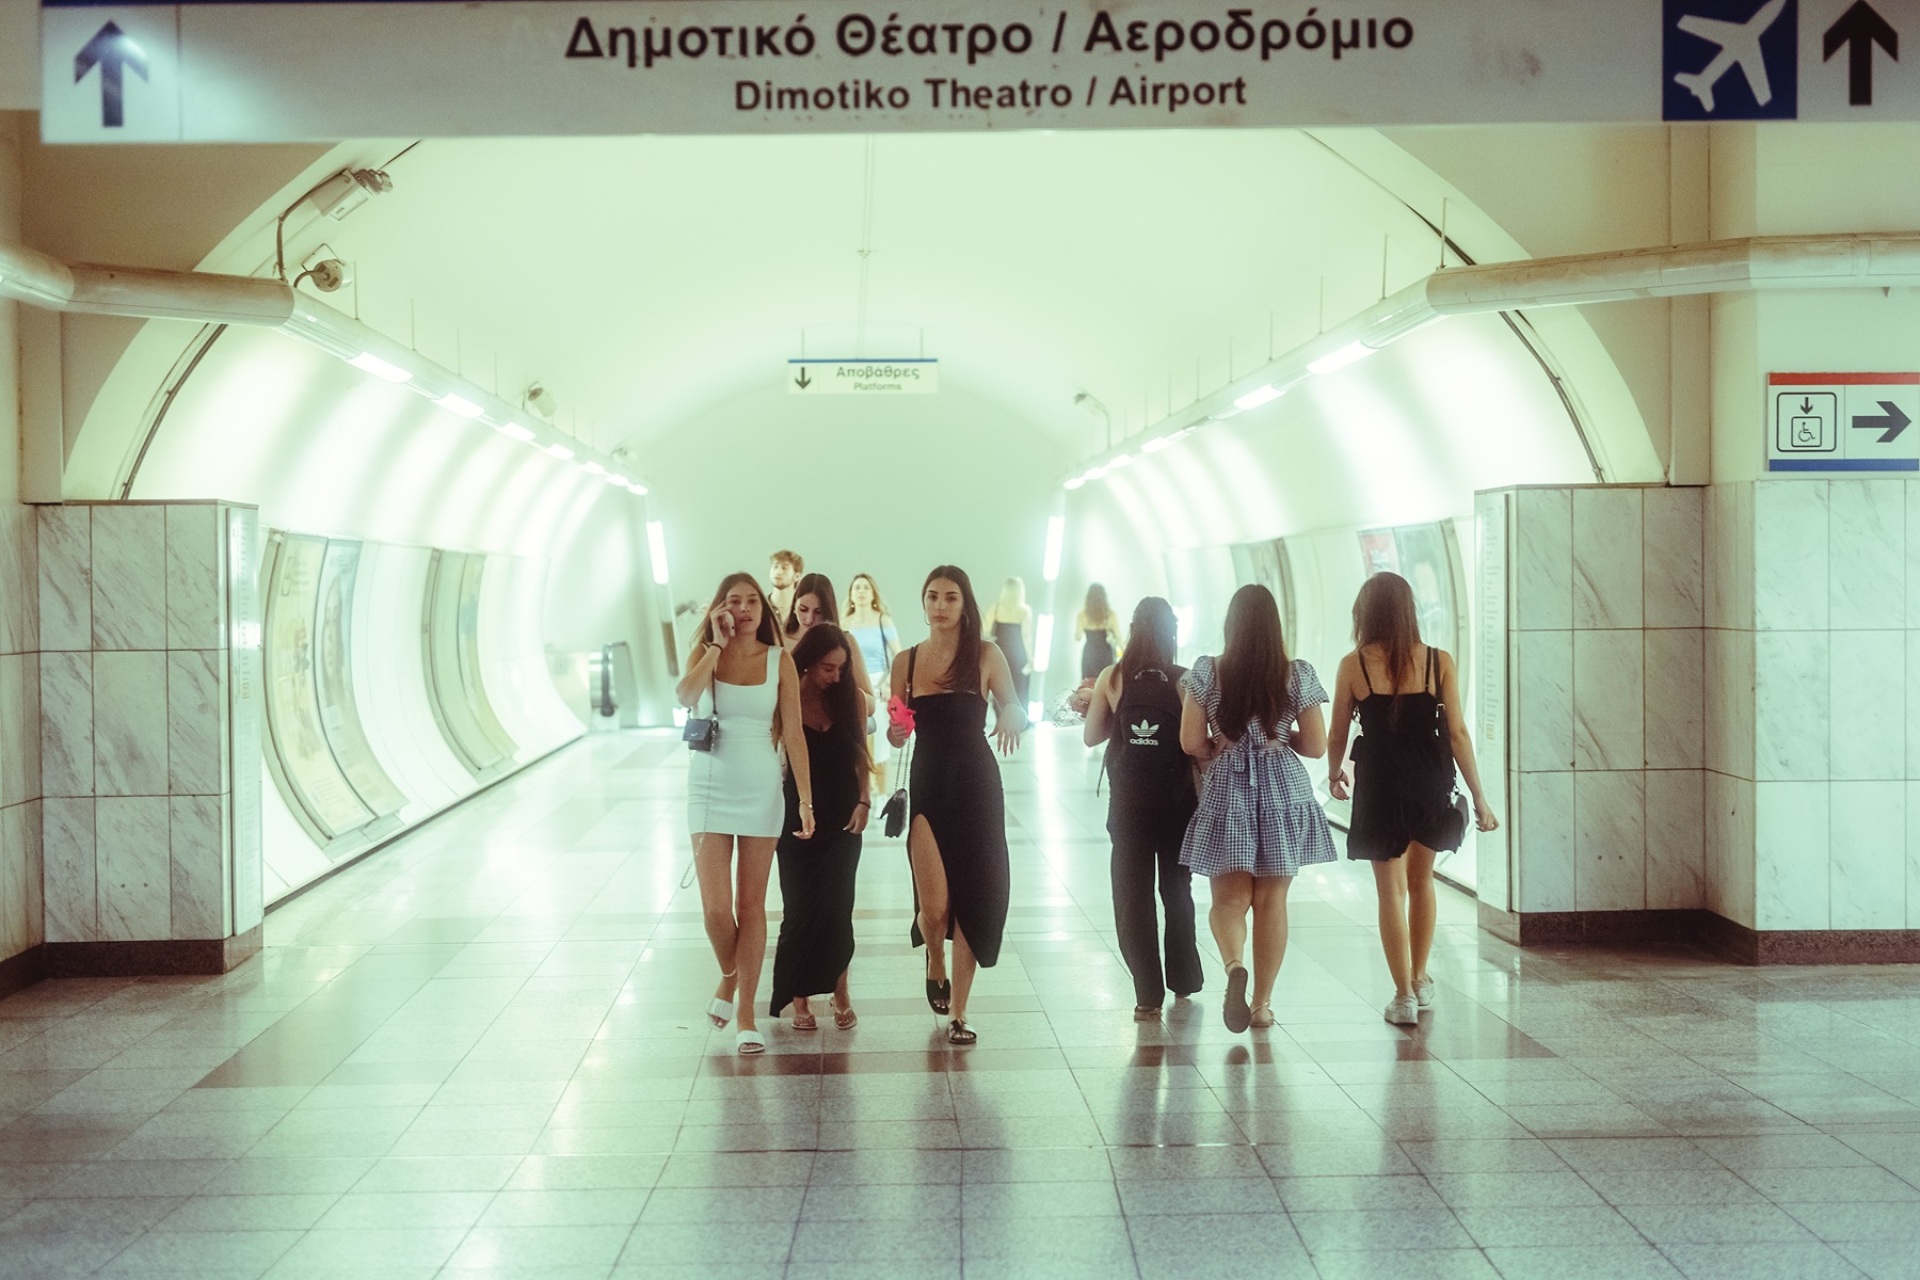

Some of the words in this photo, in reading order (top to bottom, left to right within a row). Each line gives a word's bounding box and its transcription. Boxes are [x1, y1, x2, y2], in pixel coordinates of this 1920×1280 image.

[565, 14, 816, 68] Δημοτικό
[836, 13, 1033, 65] Θέατρο
[1051, 11, 1068, 53] /
[1083, 7, 1415, 62] Αεροδρόμιο
[735, 79, 910, 111] Dimotiko
[924, 78, 1073, 109] Theatro
[1086, 76, 1097, 106] /
[1109, 75, 1247, 112] Airport
[836, 365, 920, 380] Αποβάθρες
[853, 381, 902, 391] Platforms
[1129, 738, 1159, 746] adidas
